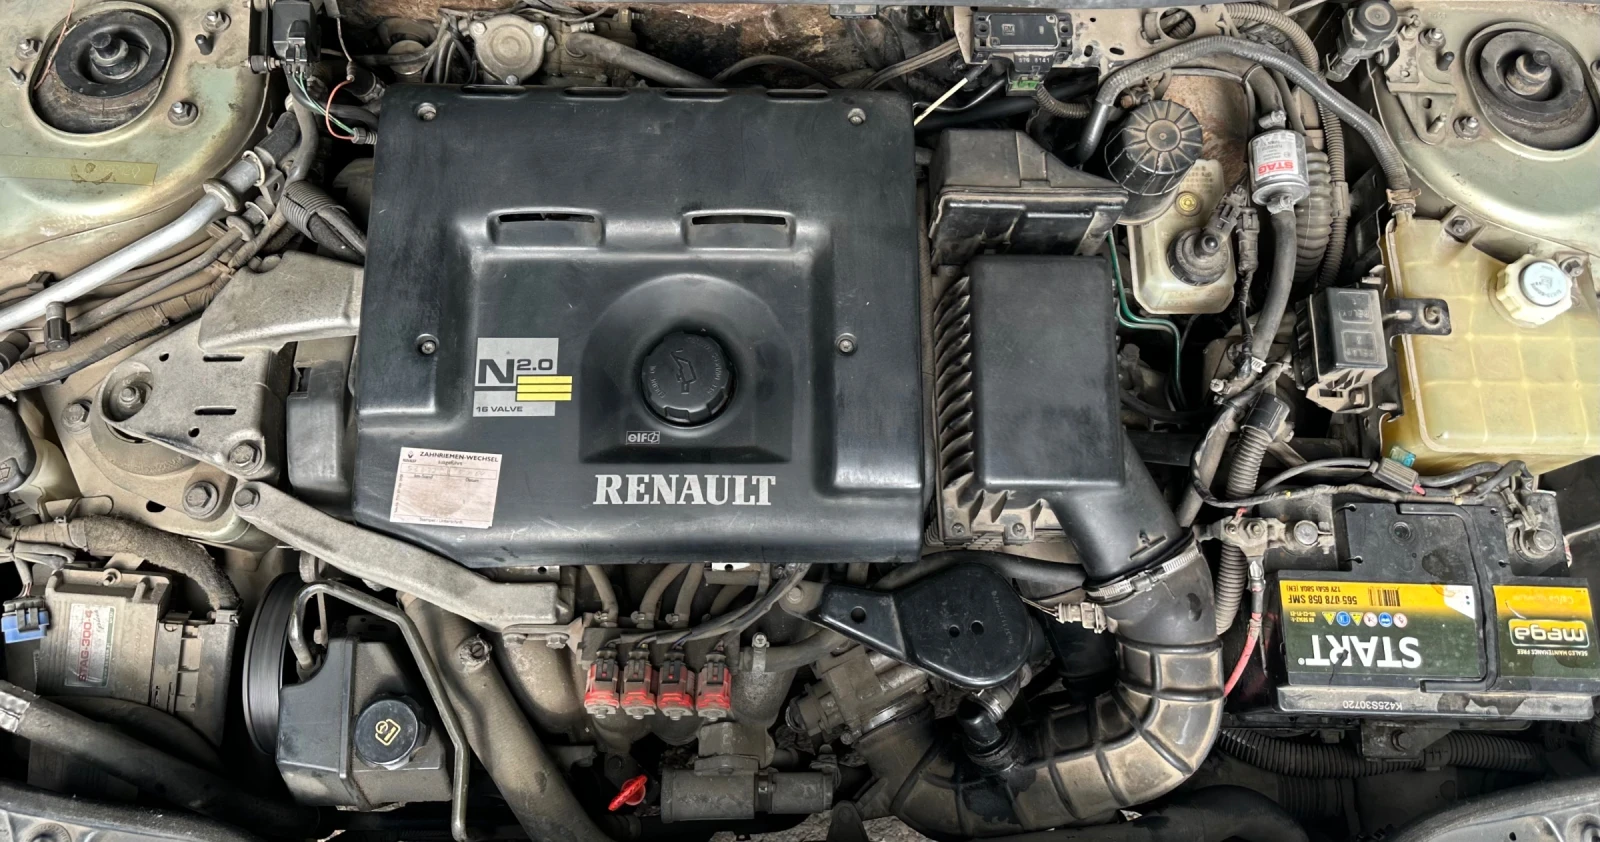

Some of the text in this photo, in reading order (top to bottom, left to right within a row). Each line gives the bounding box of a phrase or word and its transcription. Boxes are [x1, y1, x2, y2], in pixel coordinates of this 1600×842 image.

[1258, 161, 1294, 175] STAG
[478, 359, 553, 385] N 2.0
[627, 432, 648, 443] elf
[419, 451, 499, 463] ZAHNRIEMEN-WECHSEL
[593, 474, 776, 506] RENAULT
[1288, 594, 1358, 605] 565 078 058 SMF
[1514, 624, 1585, 642] mega
[79, 610, 93, 682] STAG-300-4
[1343, 700, 1403, 711] K425S30720
